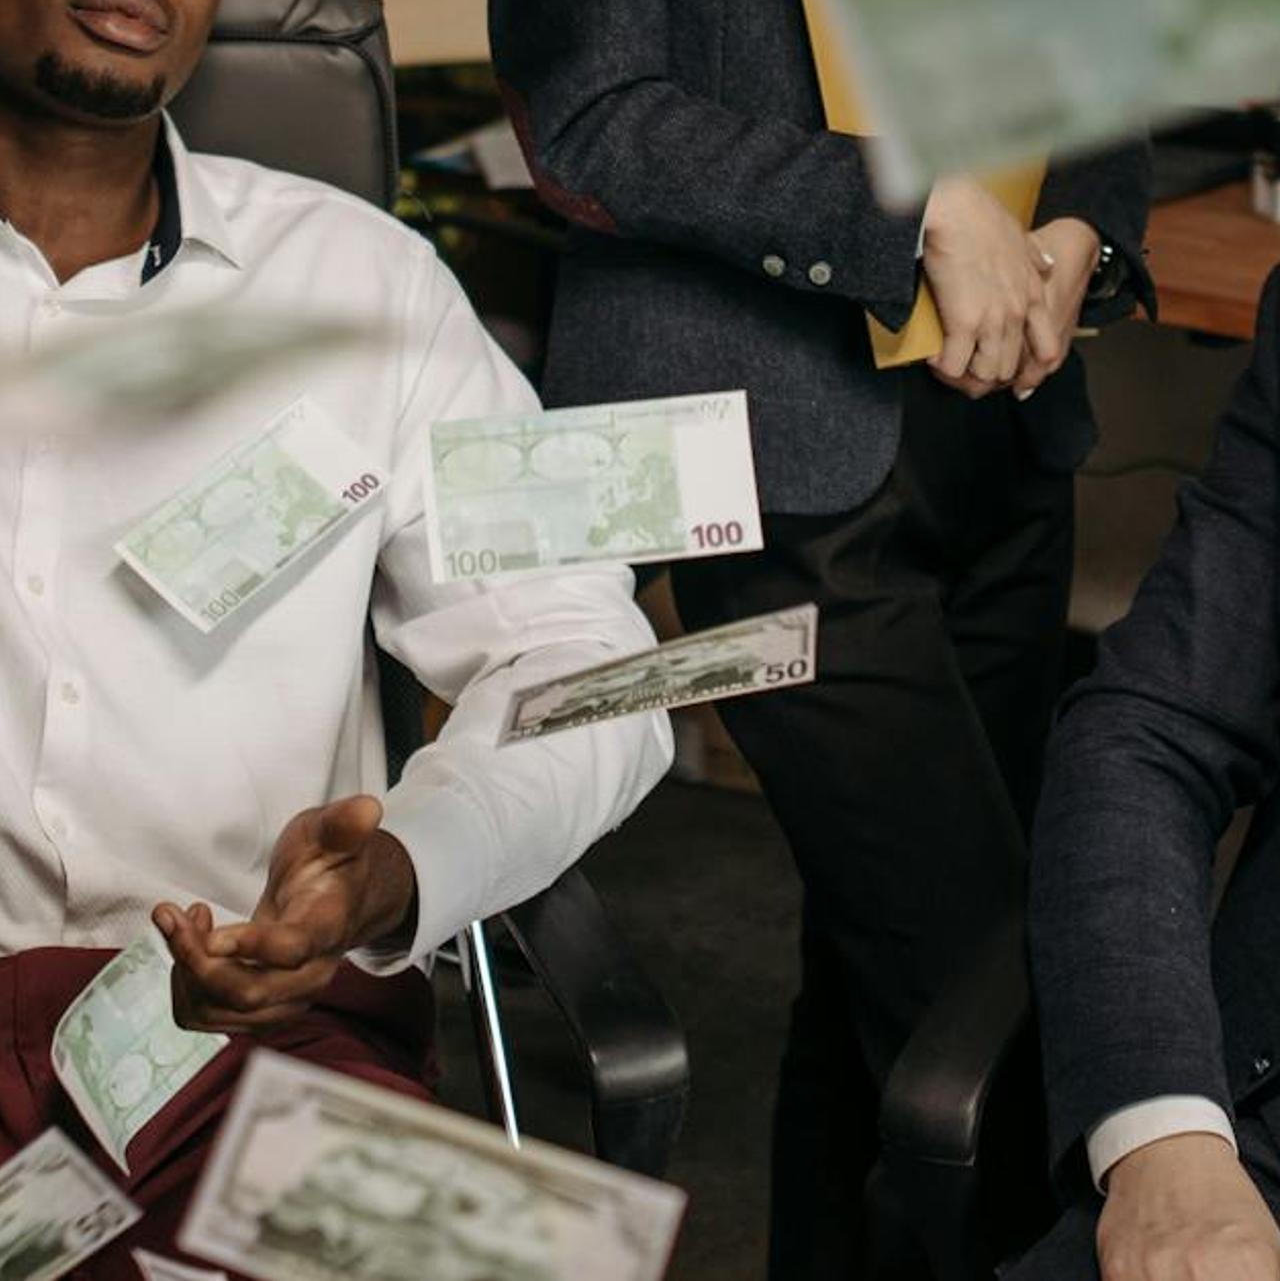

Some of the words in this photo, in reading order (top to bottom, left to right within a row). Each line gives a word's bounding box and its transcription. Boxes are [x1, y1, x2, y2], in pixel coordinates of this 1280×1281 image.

[341, 473, 381, 505] 100
[691, 521, 744, 549] 100
[445, 548, 498, 577] 100
[200, 584, 242, 624] 100
[764, 660, 808, 683] 50
